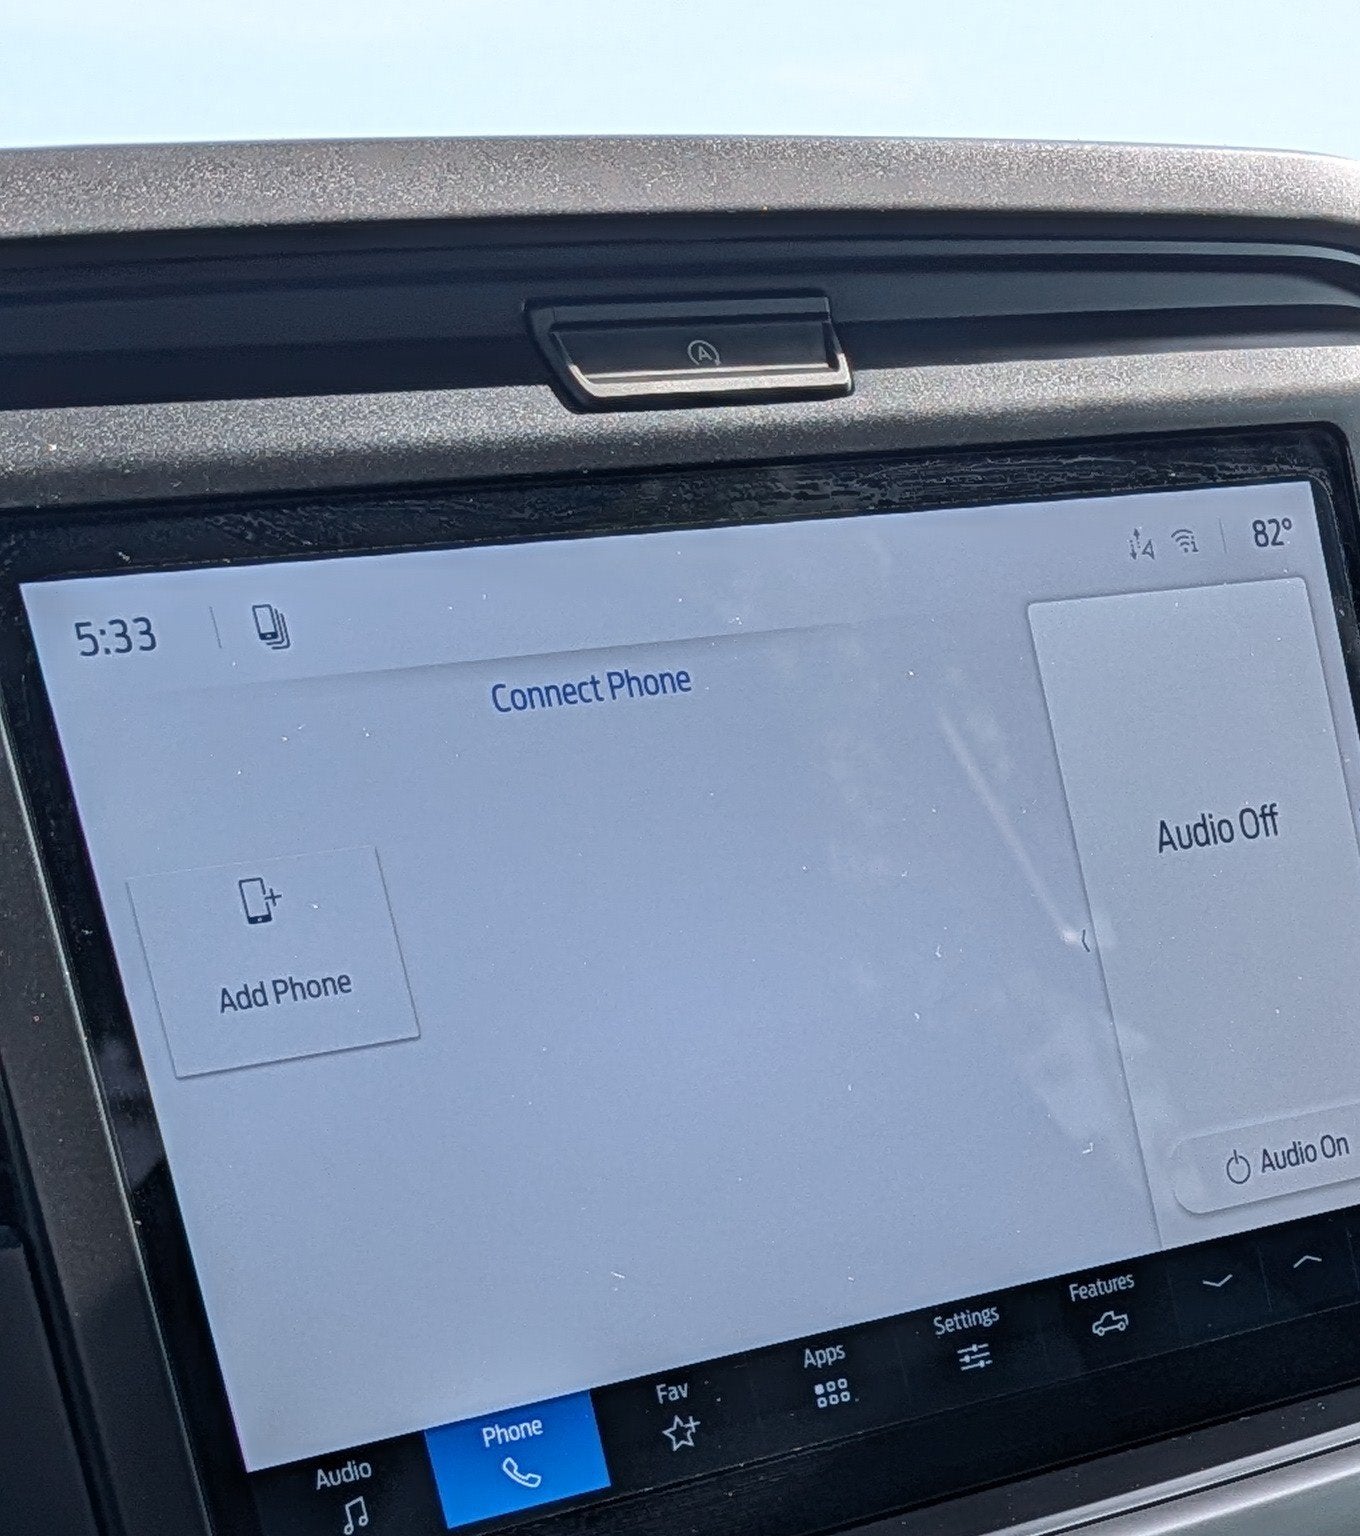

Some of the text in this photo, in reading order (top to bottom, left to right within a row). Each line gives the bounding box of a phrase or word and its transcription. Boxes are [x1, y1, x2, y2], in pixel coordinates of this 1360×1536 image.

[1252, 517, 1293, 548] 82°
[74, 616, 158, 657] 5:33
[490, 665, 693, 714] Connect Phone
[1156, 803, 1281, 853] Audio Off
[218, 970, 353, 1014] Add Phone
[1259, 1132, 1350, 1174] Audio On
[1069, 1271, 1135, 1302] Features
[933, 1302, 1000, 1338] Settings
[803, 1342, 846, 1372] Apps
[656, 1381, 689, 1404] Fav
[481, 1416, 543, 1448] Phone
[315, 1457, 372, 1491] Audio
